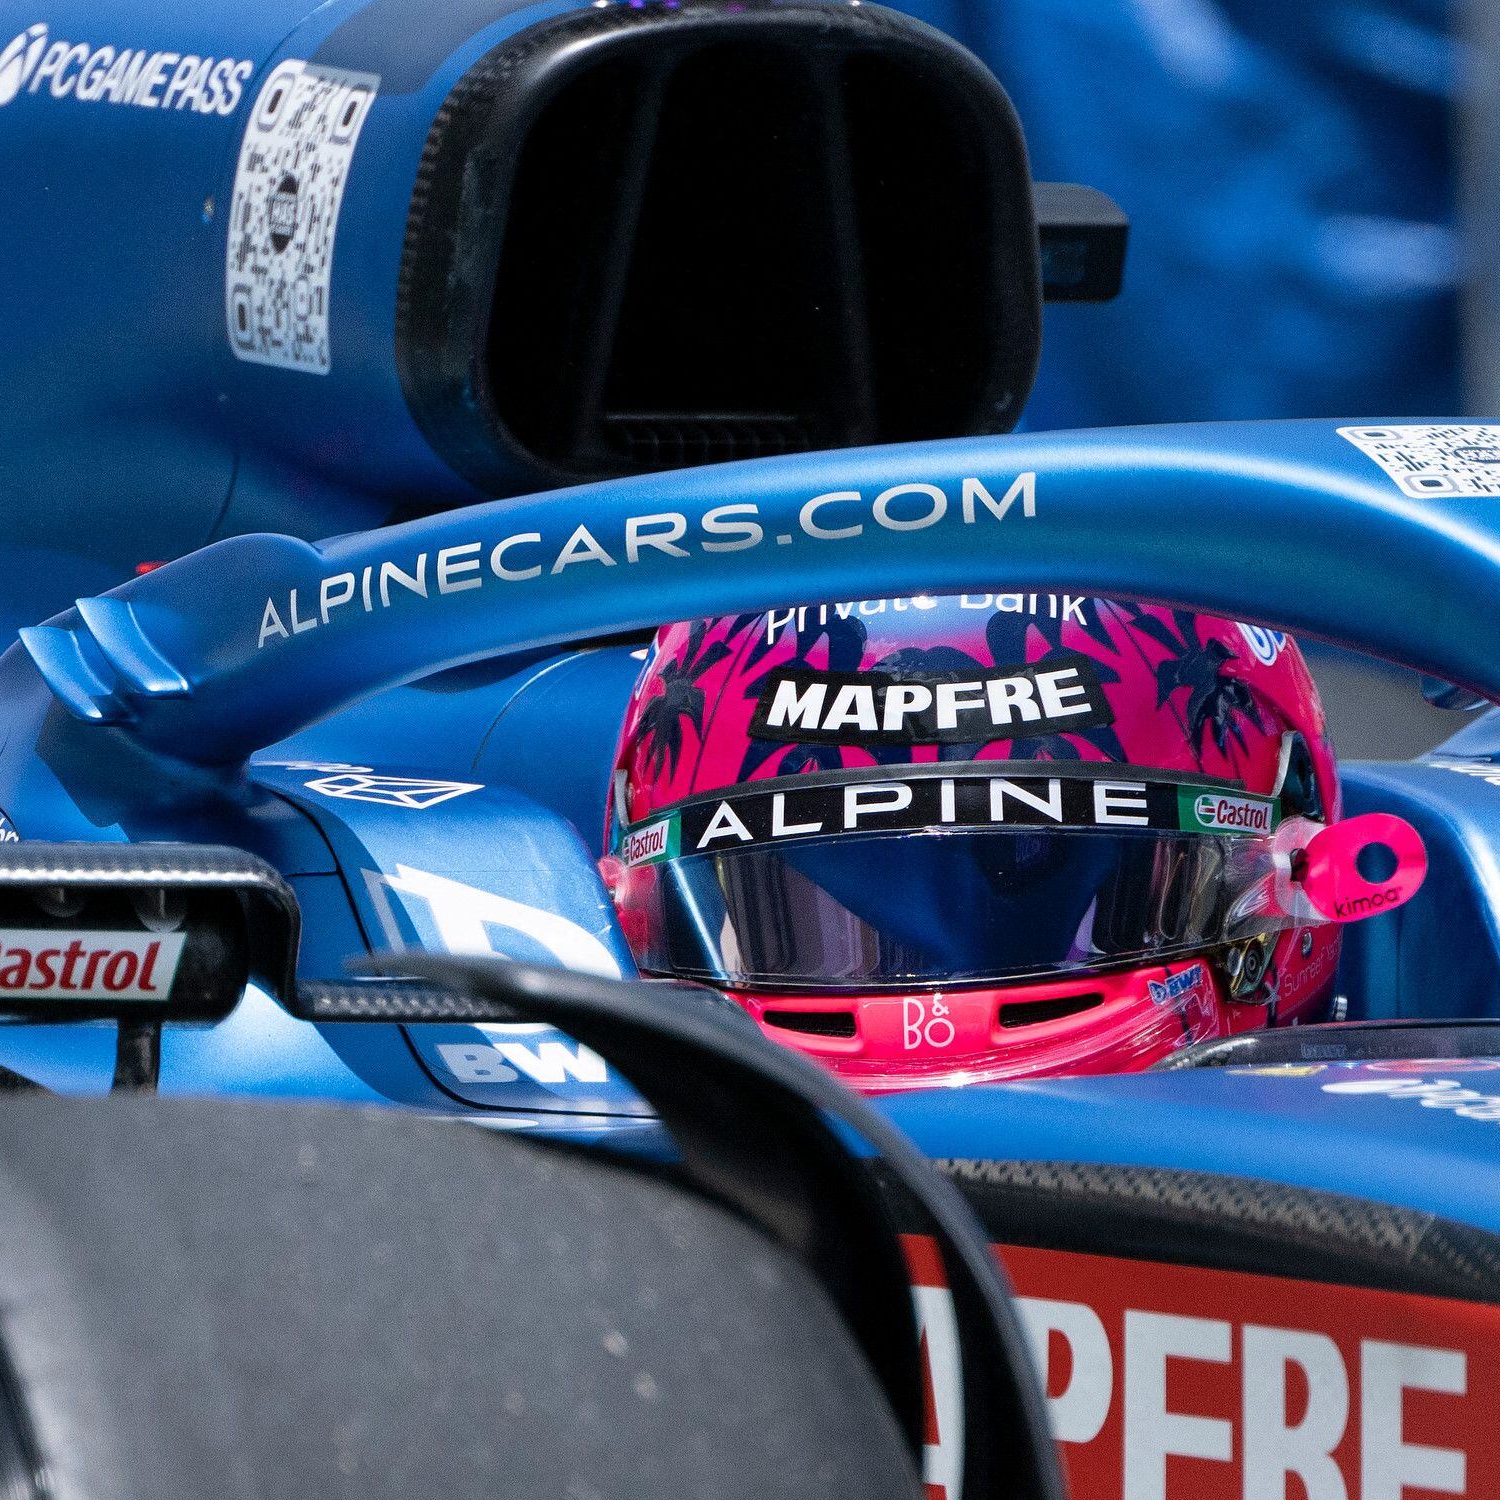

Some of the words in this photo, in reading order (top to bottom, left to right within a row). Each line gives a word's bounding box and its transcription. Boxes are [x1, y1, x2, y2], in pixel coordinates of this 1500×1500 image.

[257, 471, 1038, 649] ALPINECARS.COM
[766, 667, 1092, 731] MAPFRE
[696, 778, 1150, 850] ALPINE
[1215, 799, 1270, 831] Castrol
[629, 824, 665, 860] Castrol
[1334, 889, 1399, 919] kimoa
